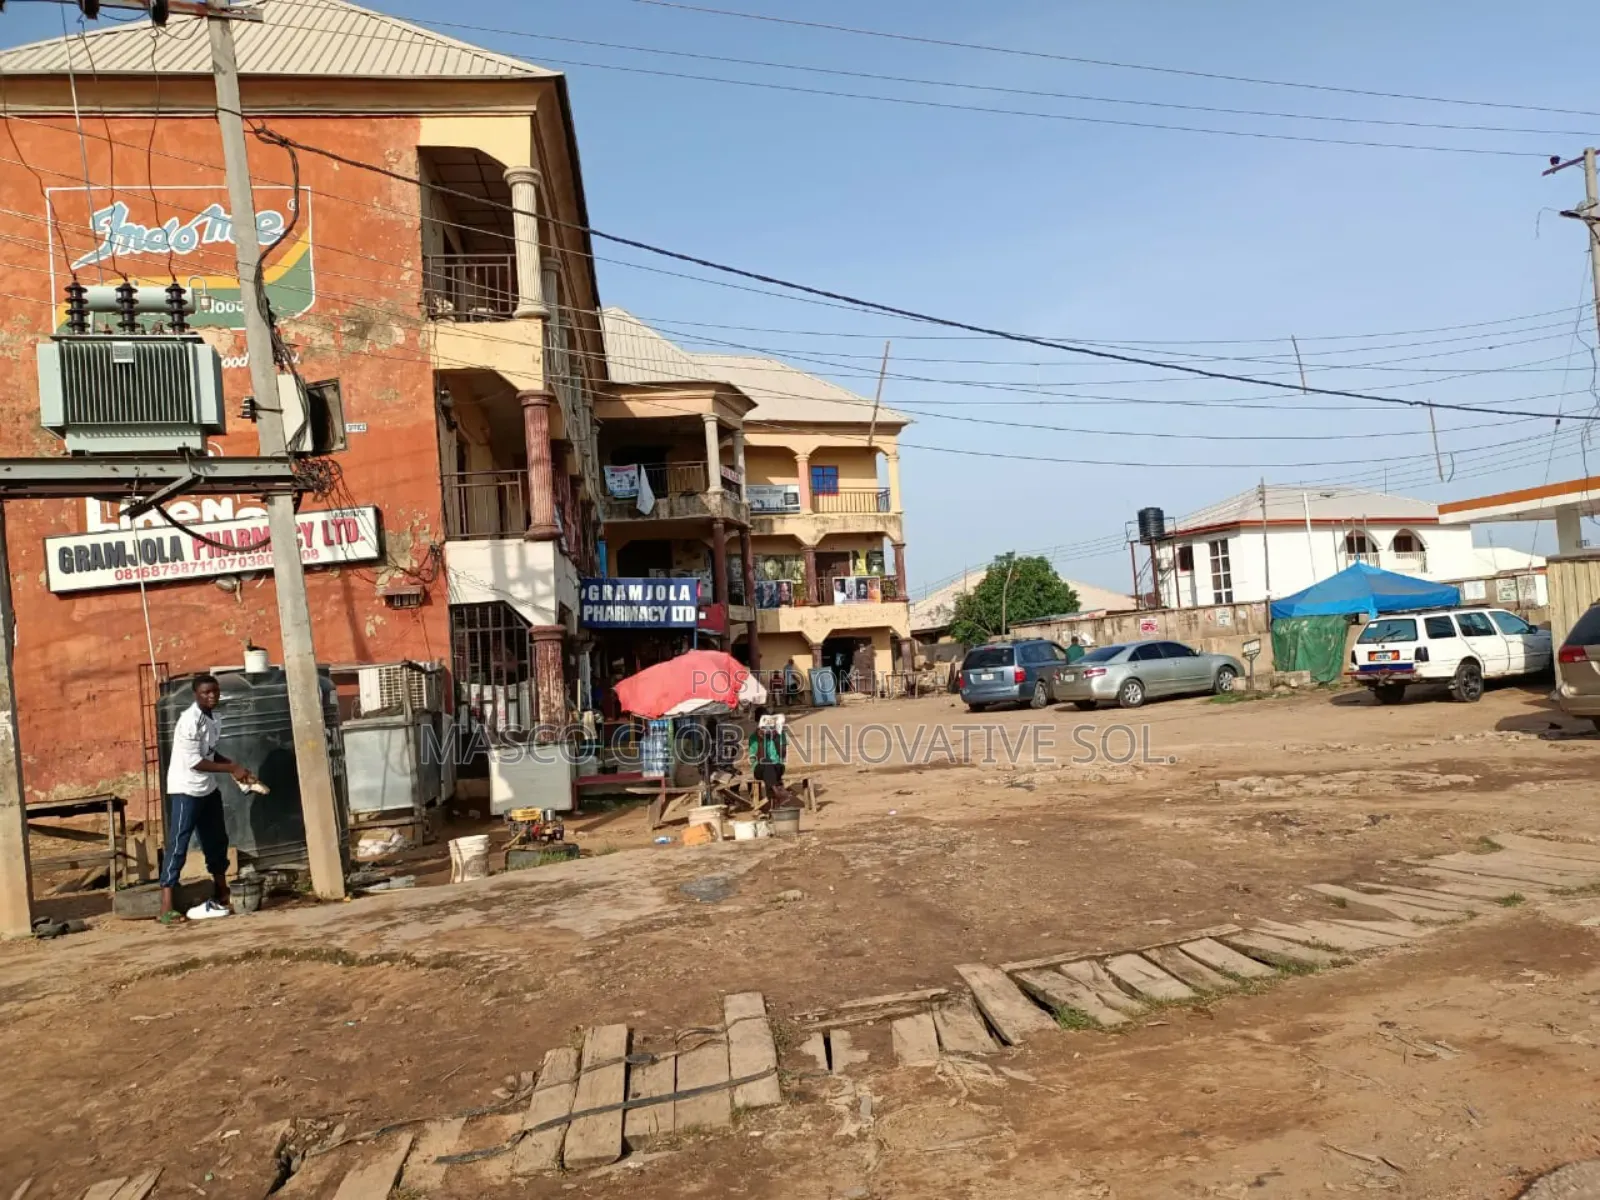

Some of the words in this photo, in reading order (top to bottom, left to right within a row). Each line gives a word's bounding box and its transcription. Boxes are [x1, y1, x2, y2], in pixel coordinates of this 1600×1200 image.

[71, 200, 285, 270] Indome
[58, 535, 185, 575] GRAMJOLA
[192, 519, 314, 560] PHARMY
[321, 518, 366, 547] LTD.
[588, 584, 691, 601] GRAMJOLA
[583, 604, 668, 622] PHARMACY
[671, 604, 696, 622] LTD
